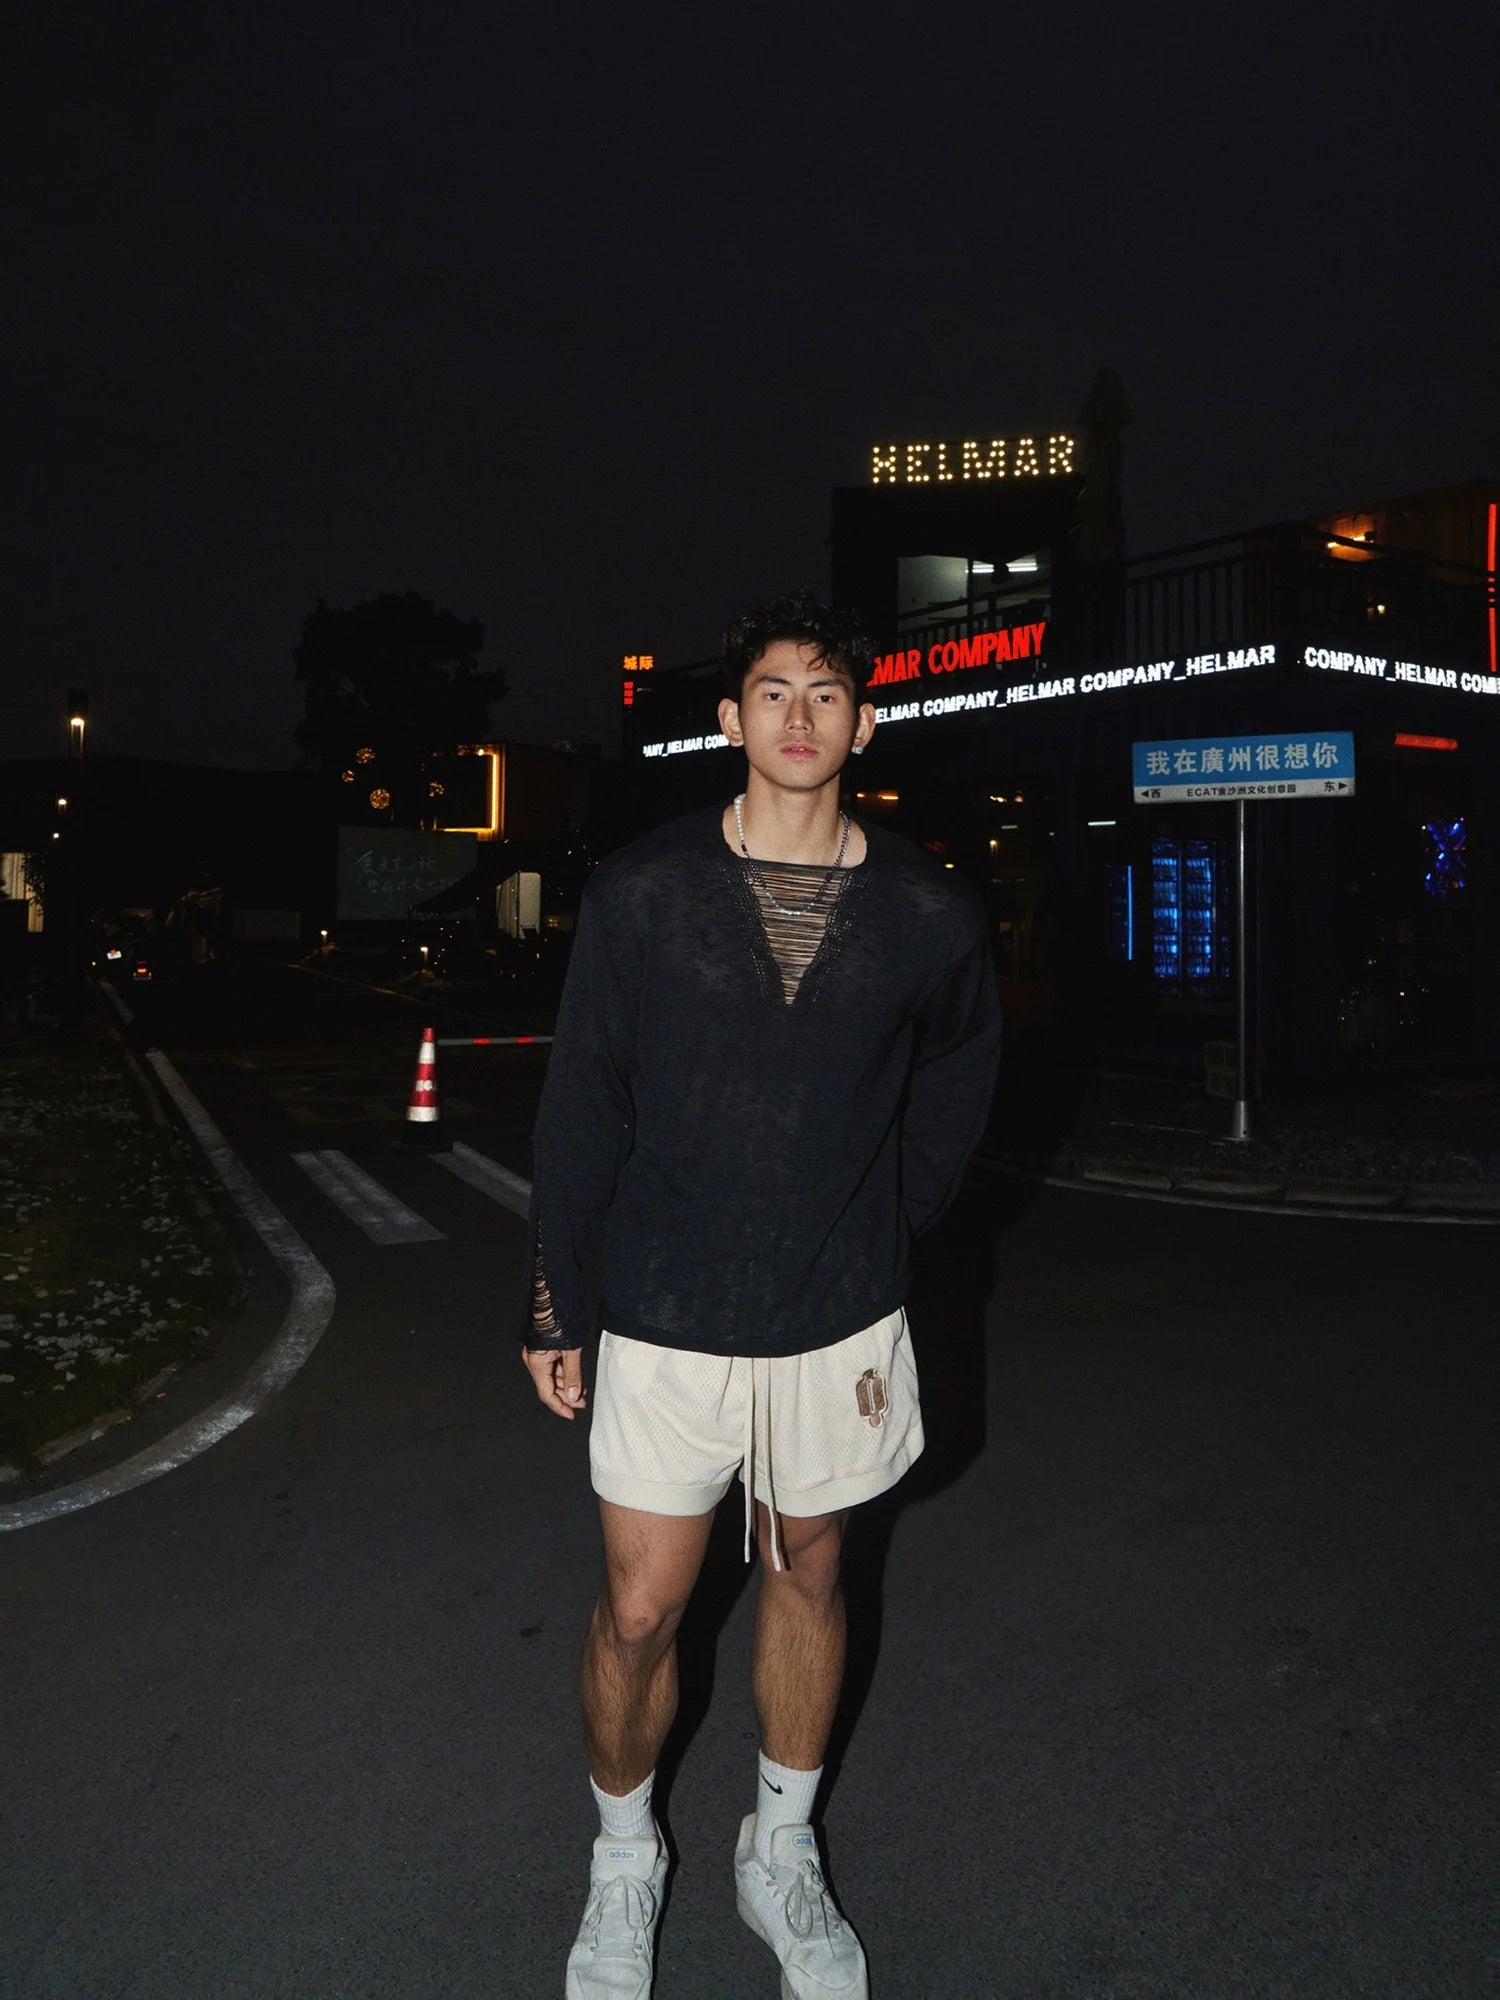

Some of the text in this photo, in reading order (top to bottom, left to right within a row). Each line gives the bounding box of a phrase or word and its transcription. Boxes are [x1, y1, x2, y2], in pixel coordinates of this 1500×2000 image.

[872, 435, 1075, 484] HELMAR
[866, 622, 1046, 687] MAR COMPANY
[1304, 646, 1458, 689] COMPANY_HELMAR
[922, 677, 1076, 717] COMPANY_HELMAR
[1079, 644, 1276, 694] COMPANY_HELMAR
[1146, 741, 1339, 776] 我在廣州很想你
[1151, 788, 1162, 799] 西
[1323, 781, 1336, 793] 东
[609, 1850, 635, 1859] adidas
